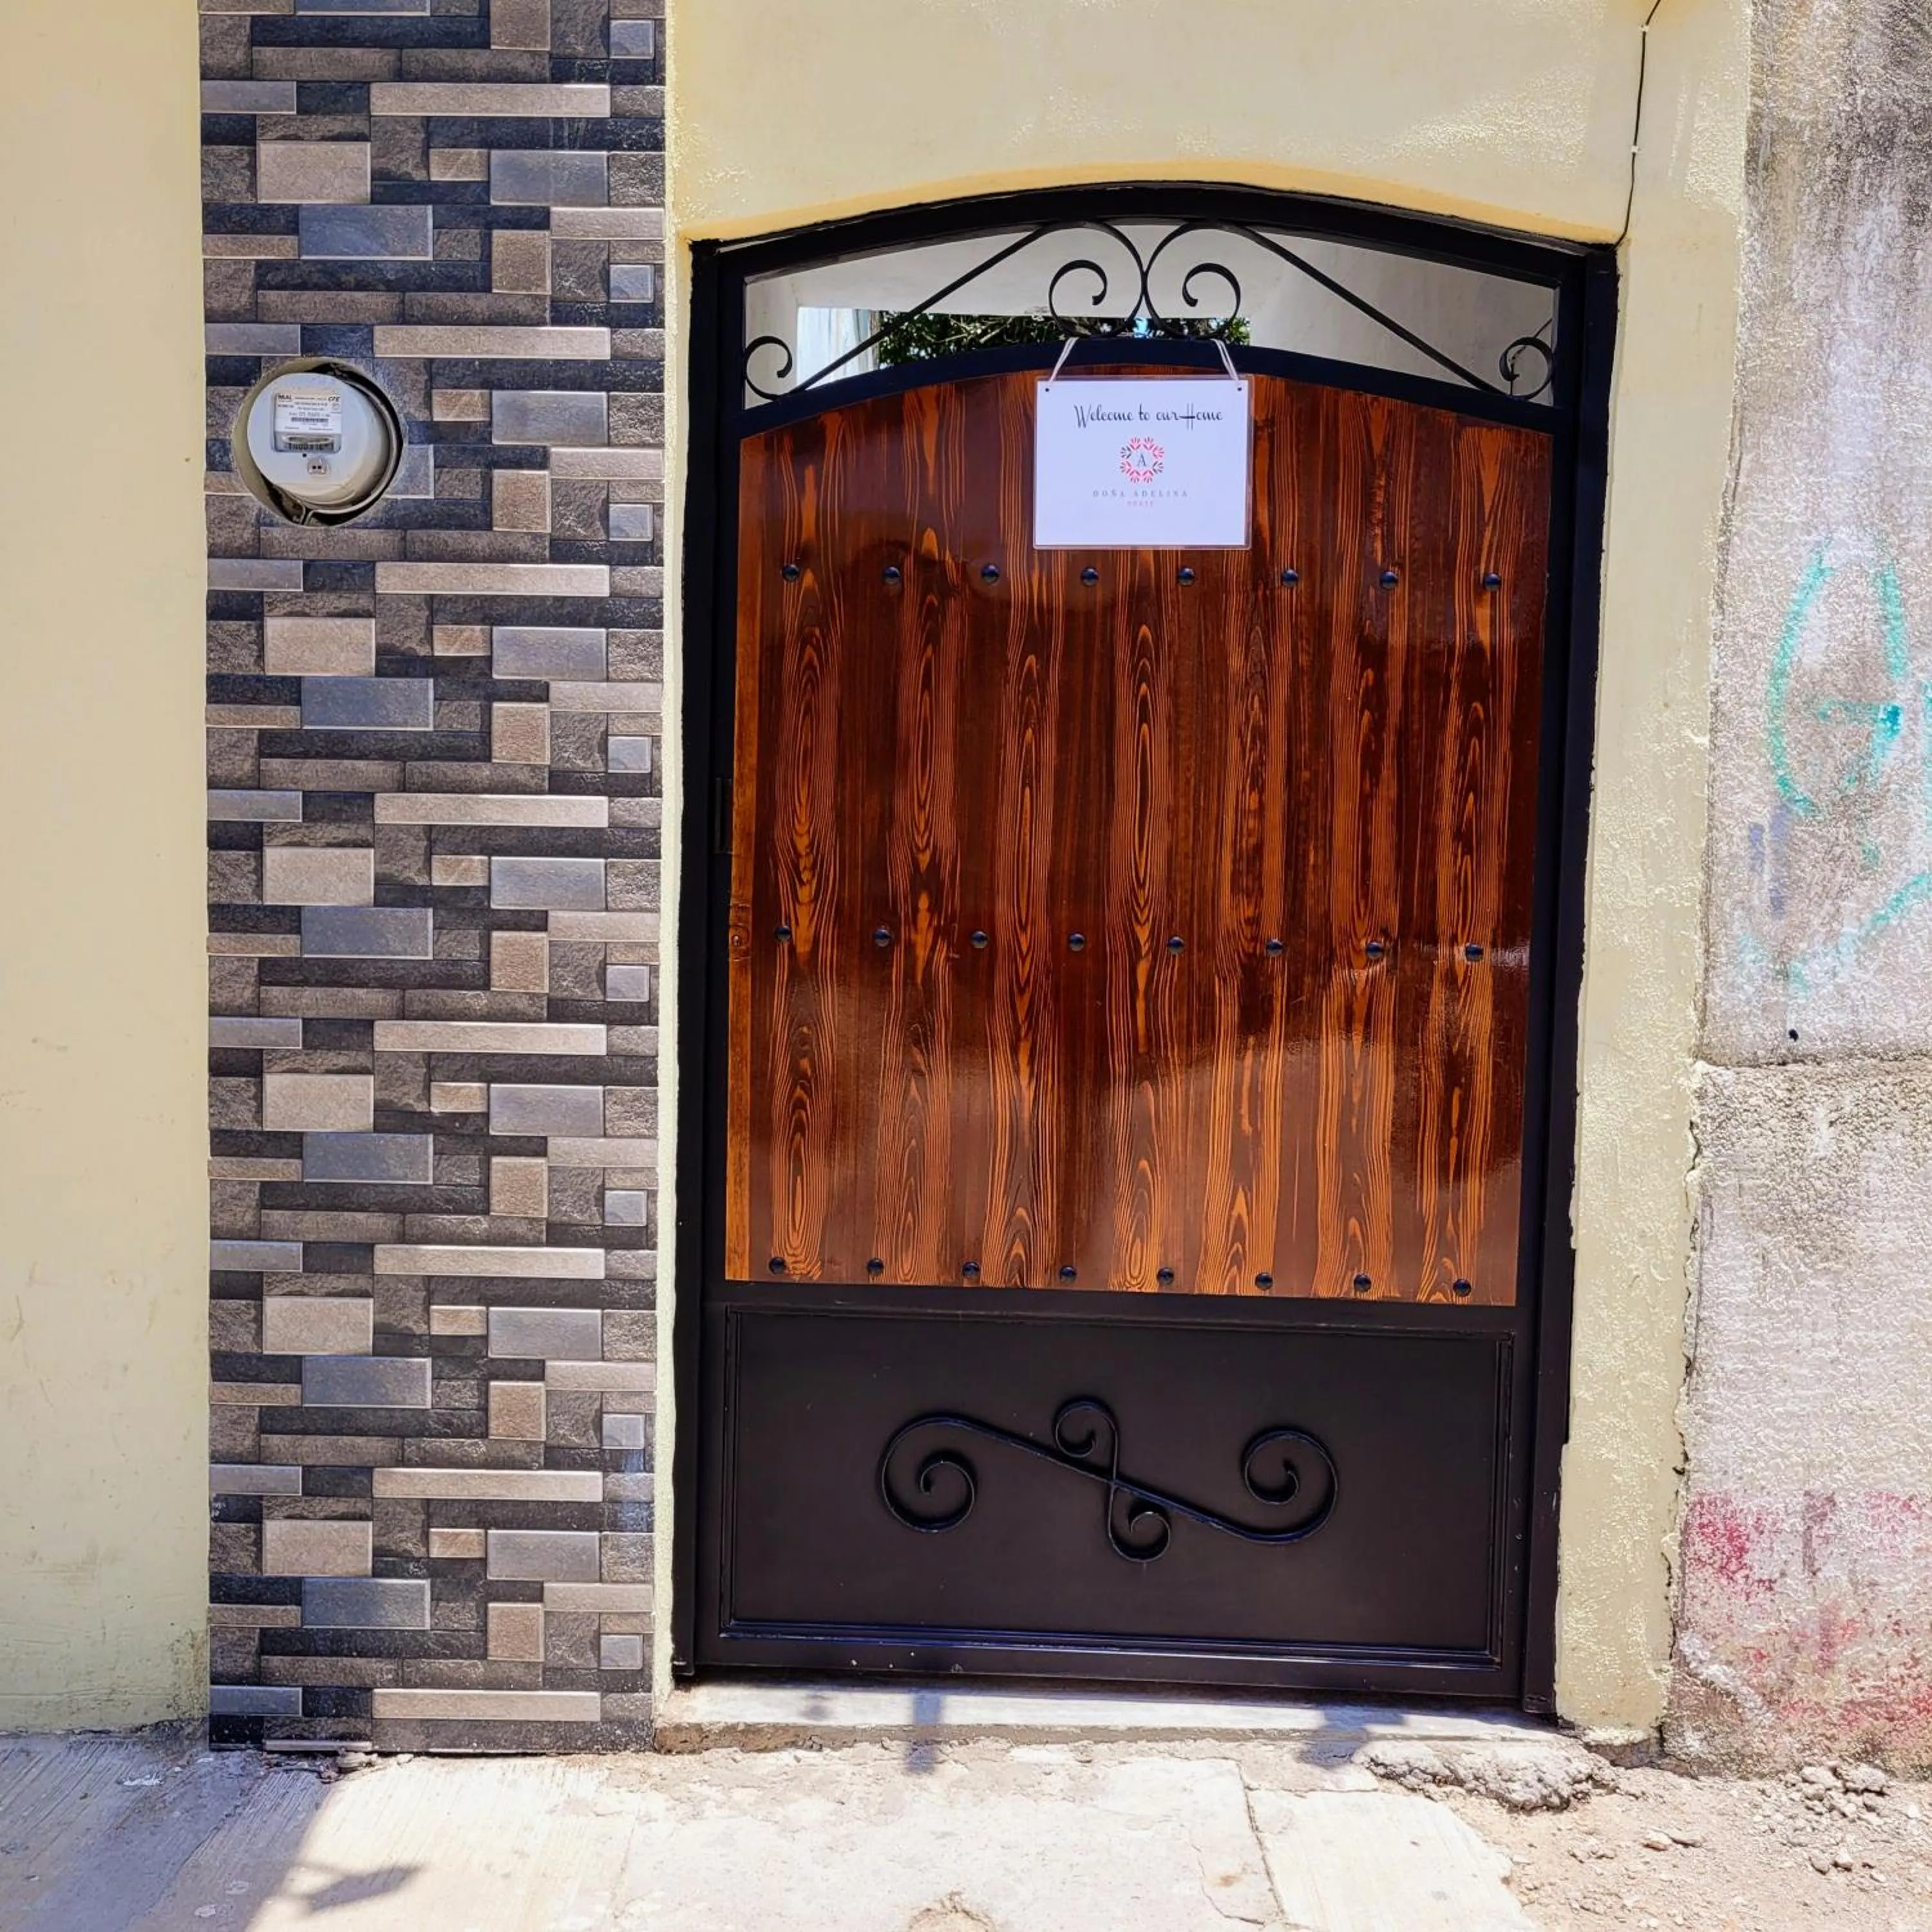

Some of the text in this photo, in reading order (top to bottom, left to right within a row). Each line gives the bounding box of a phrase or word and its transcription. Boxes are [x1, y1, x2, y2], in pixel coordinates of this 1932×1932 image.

[1074, 402, 1223, 431] Welcome to our Home
[1137, 453, 1147, 467] A
